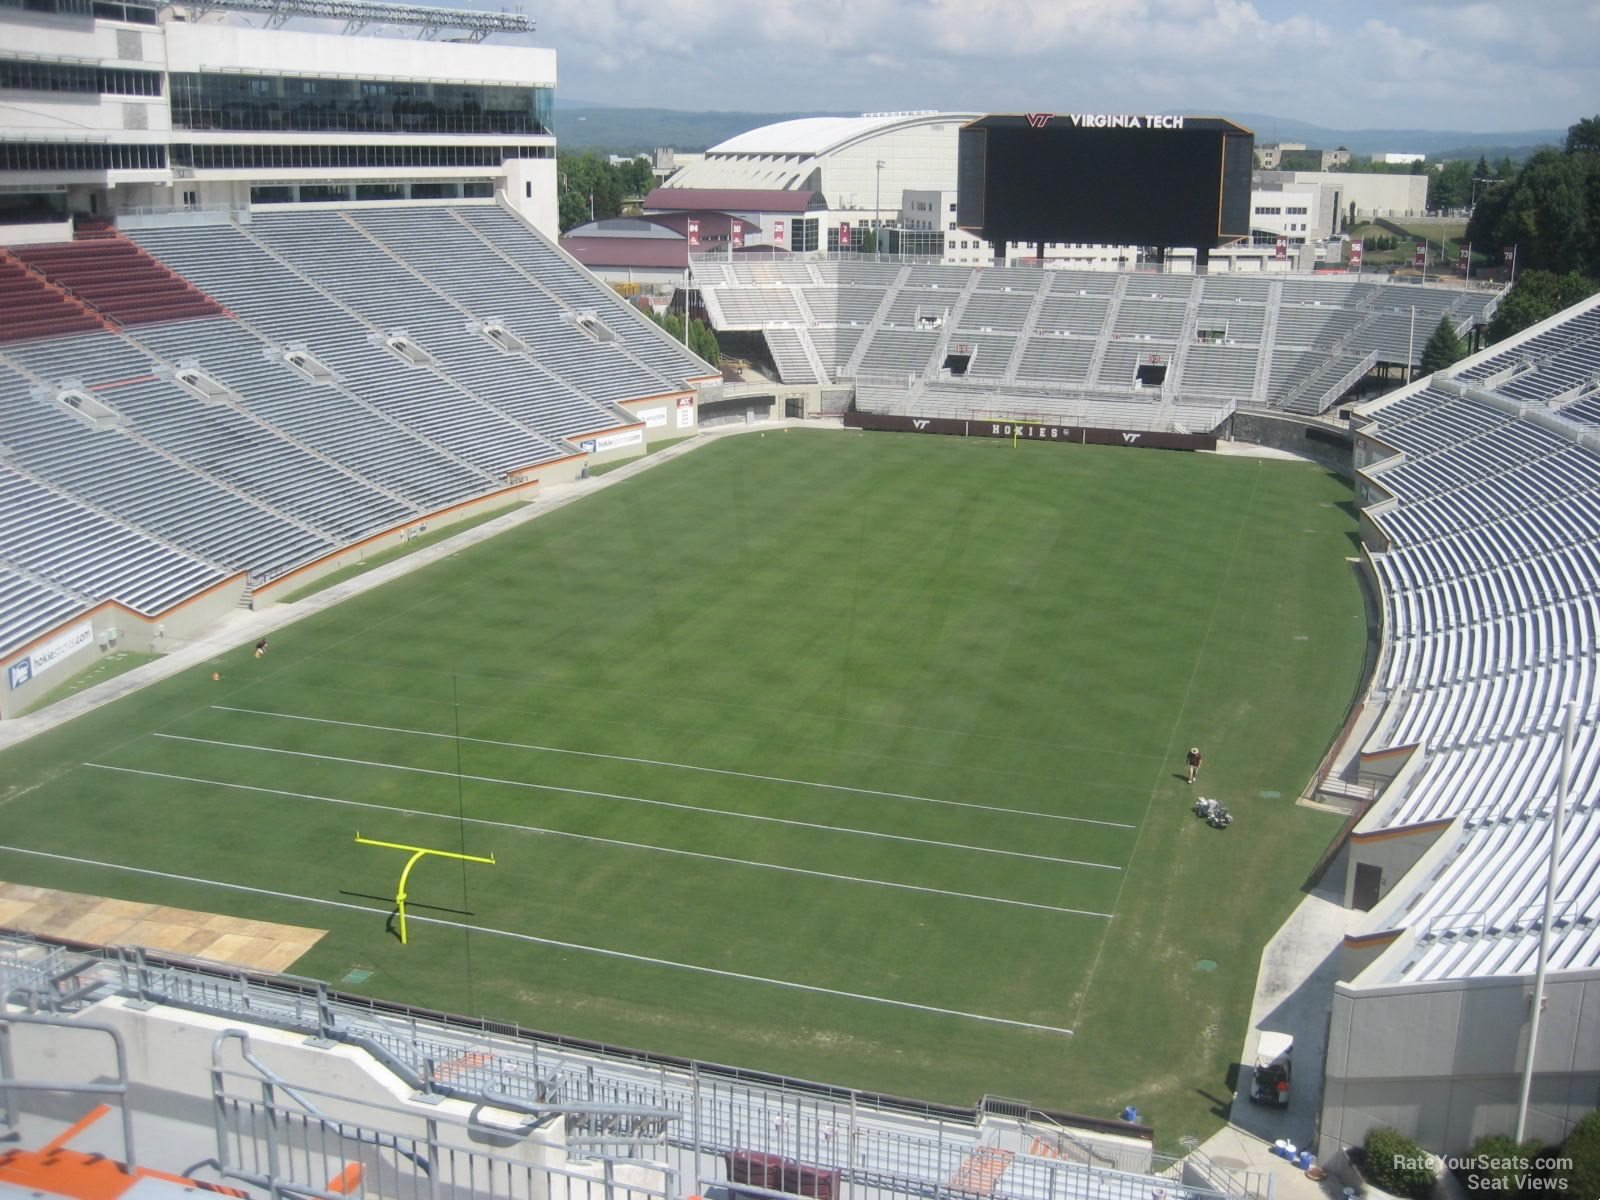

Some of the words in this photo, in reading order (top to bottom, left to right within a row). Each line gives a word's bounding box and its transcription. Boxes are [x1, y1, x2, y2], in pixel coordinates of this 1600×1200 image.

[1025, 113, 1055, 128] VT
[1070, 114, 1141, 128] VIRGINIA
[1145, 115, 1184, 129] TECH
[842, 225, 848, 233] 7
[1460, 250, 1469, 258] 73
[912, 419, 930, 430] VT
[992, 424, 1058, 438] HOKIES
[1122, 432, 1141, 443] VT
[34, 630, 91, 668] hokiesports.com
